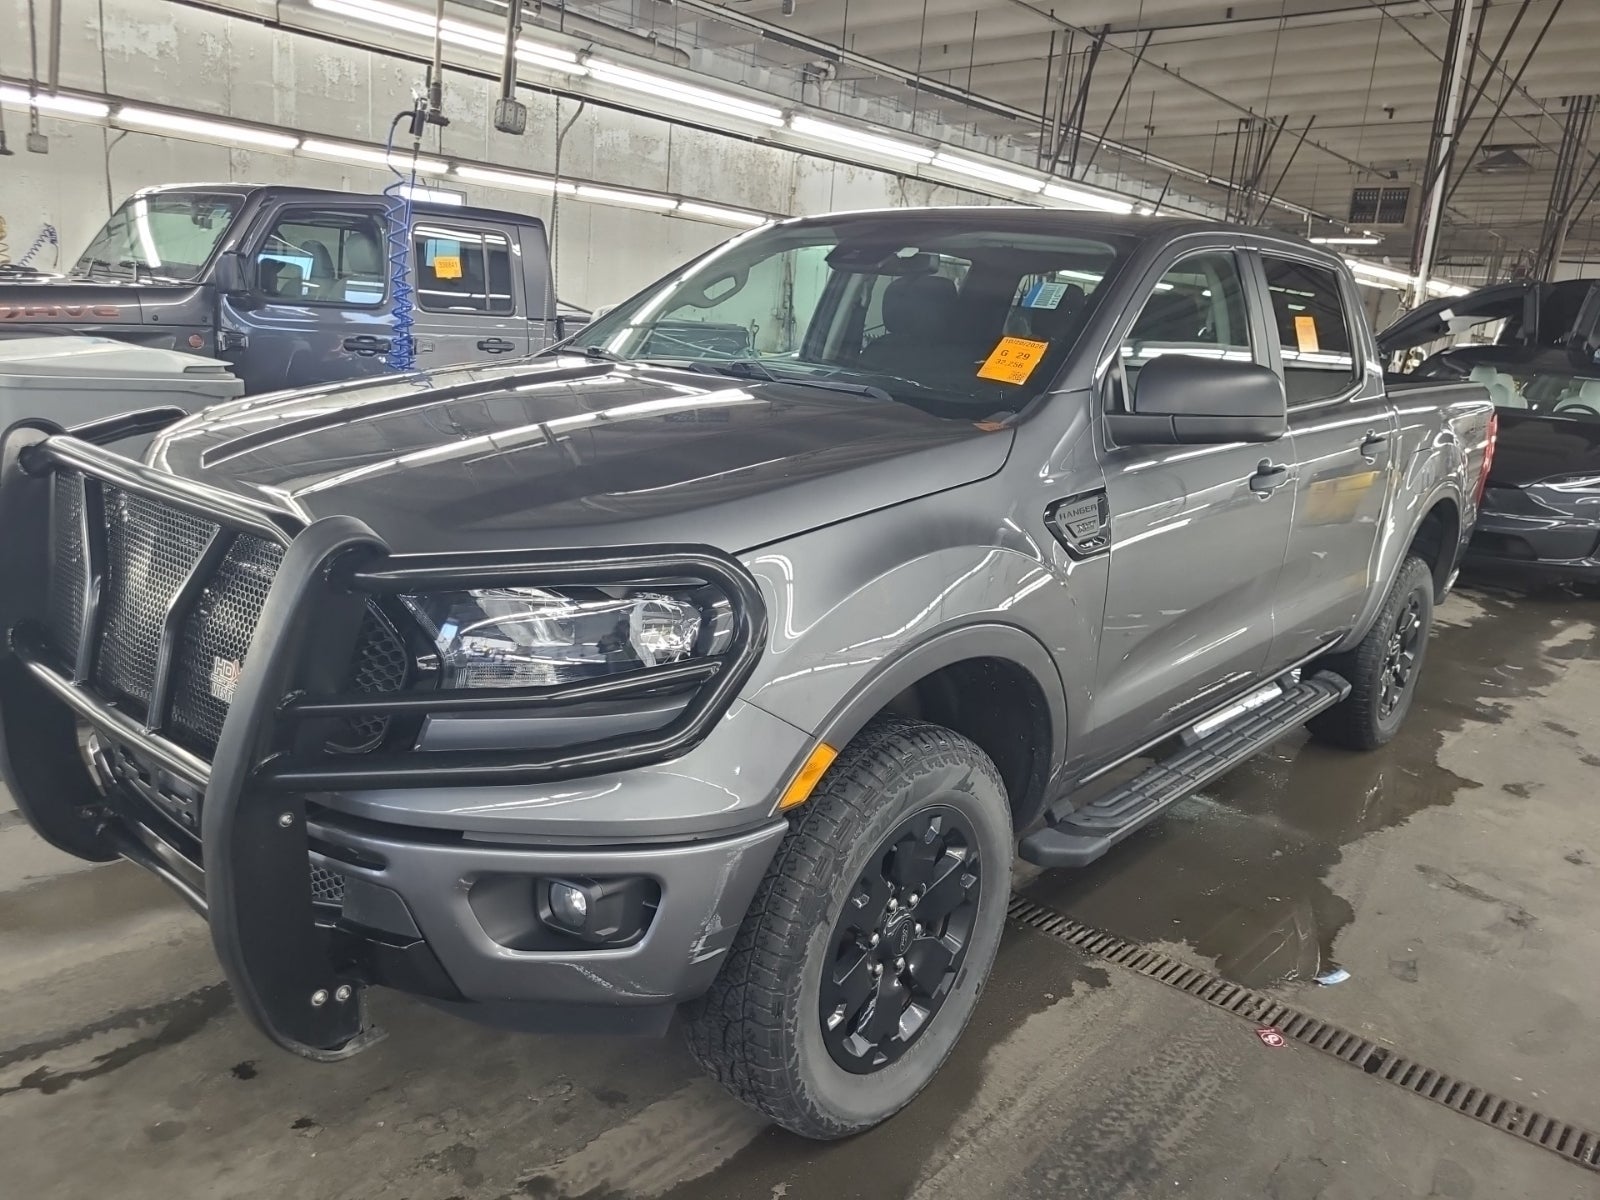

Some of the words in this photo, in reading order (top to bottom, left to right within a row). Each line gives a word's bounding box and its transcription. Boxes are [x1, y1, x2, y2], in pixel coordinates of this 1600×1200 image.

[1000, 349, 1009, 357] G
[1016, 352, 1031, 361] 29
[1059, 503, 1097, 520] RANGER
